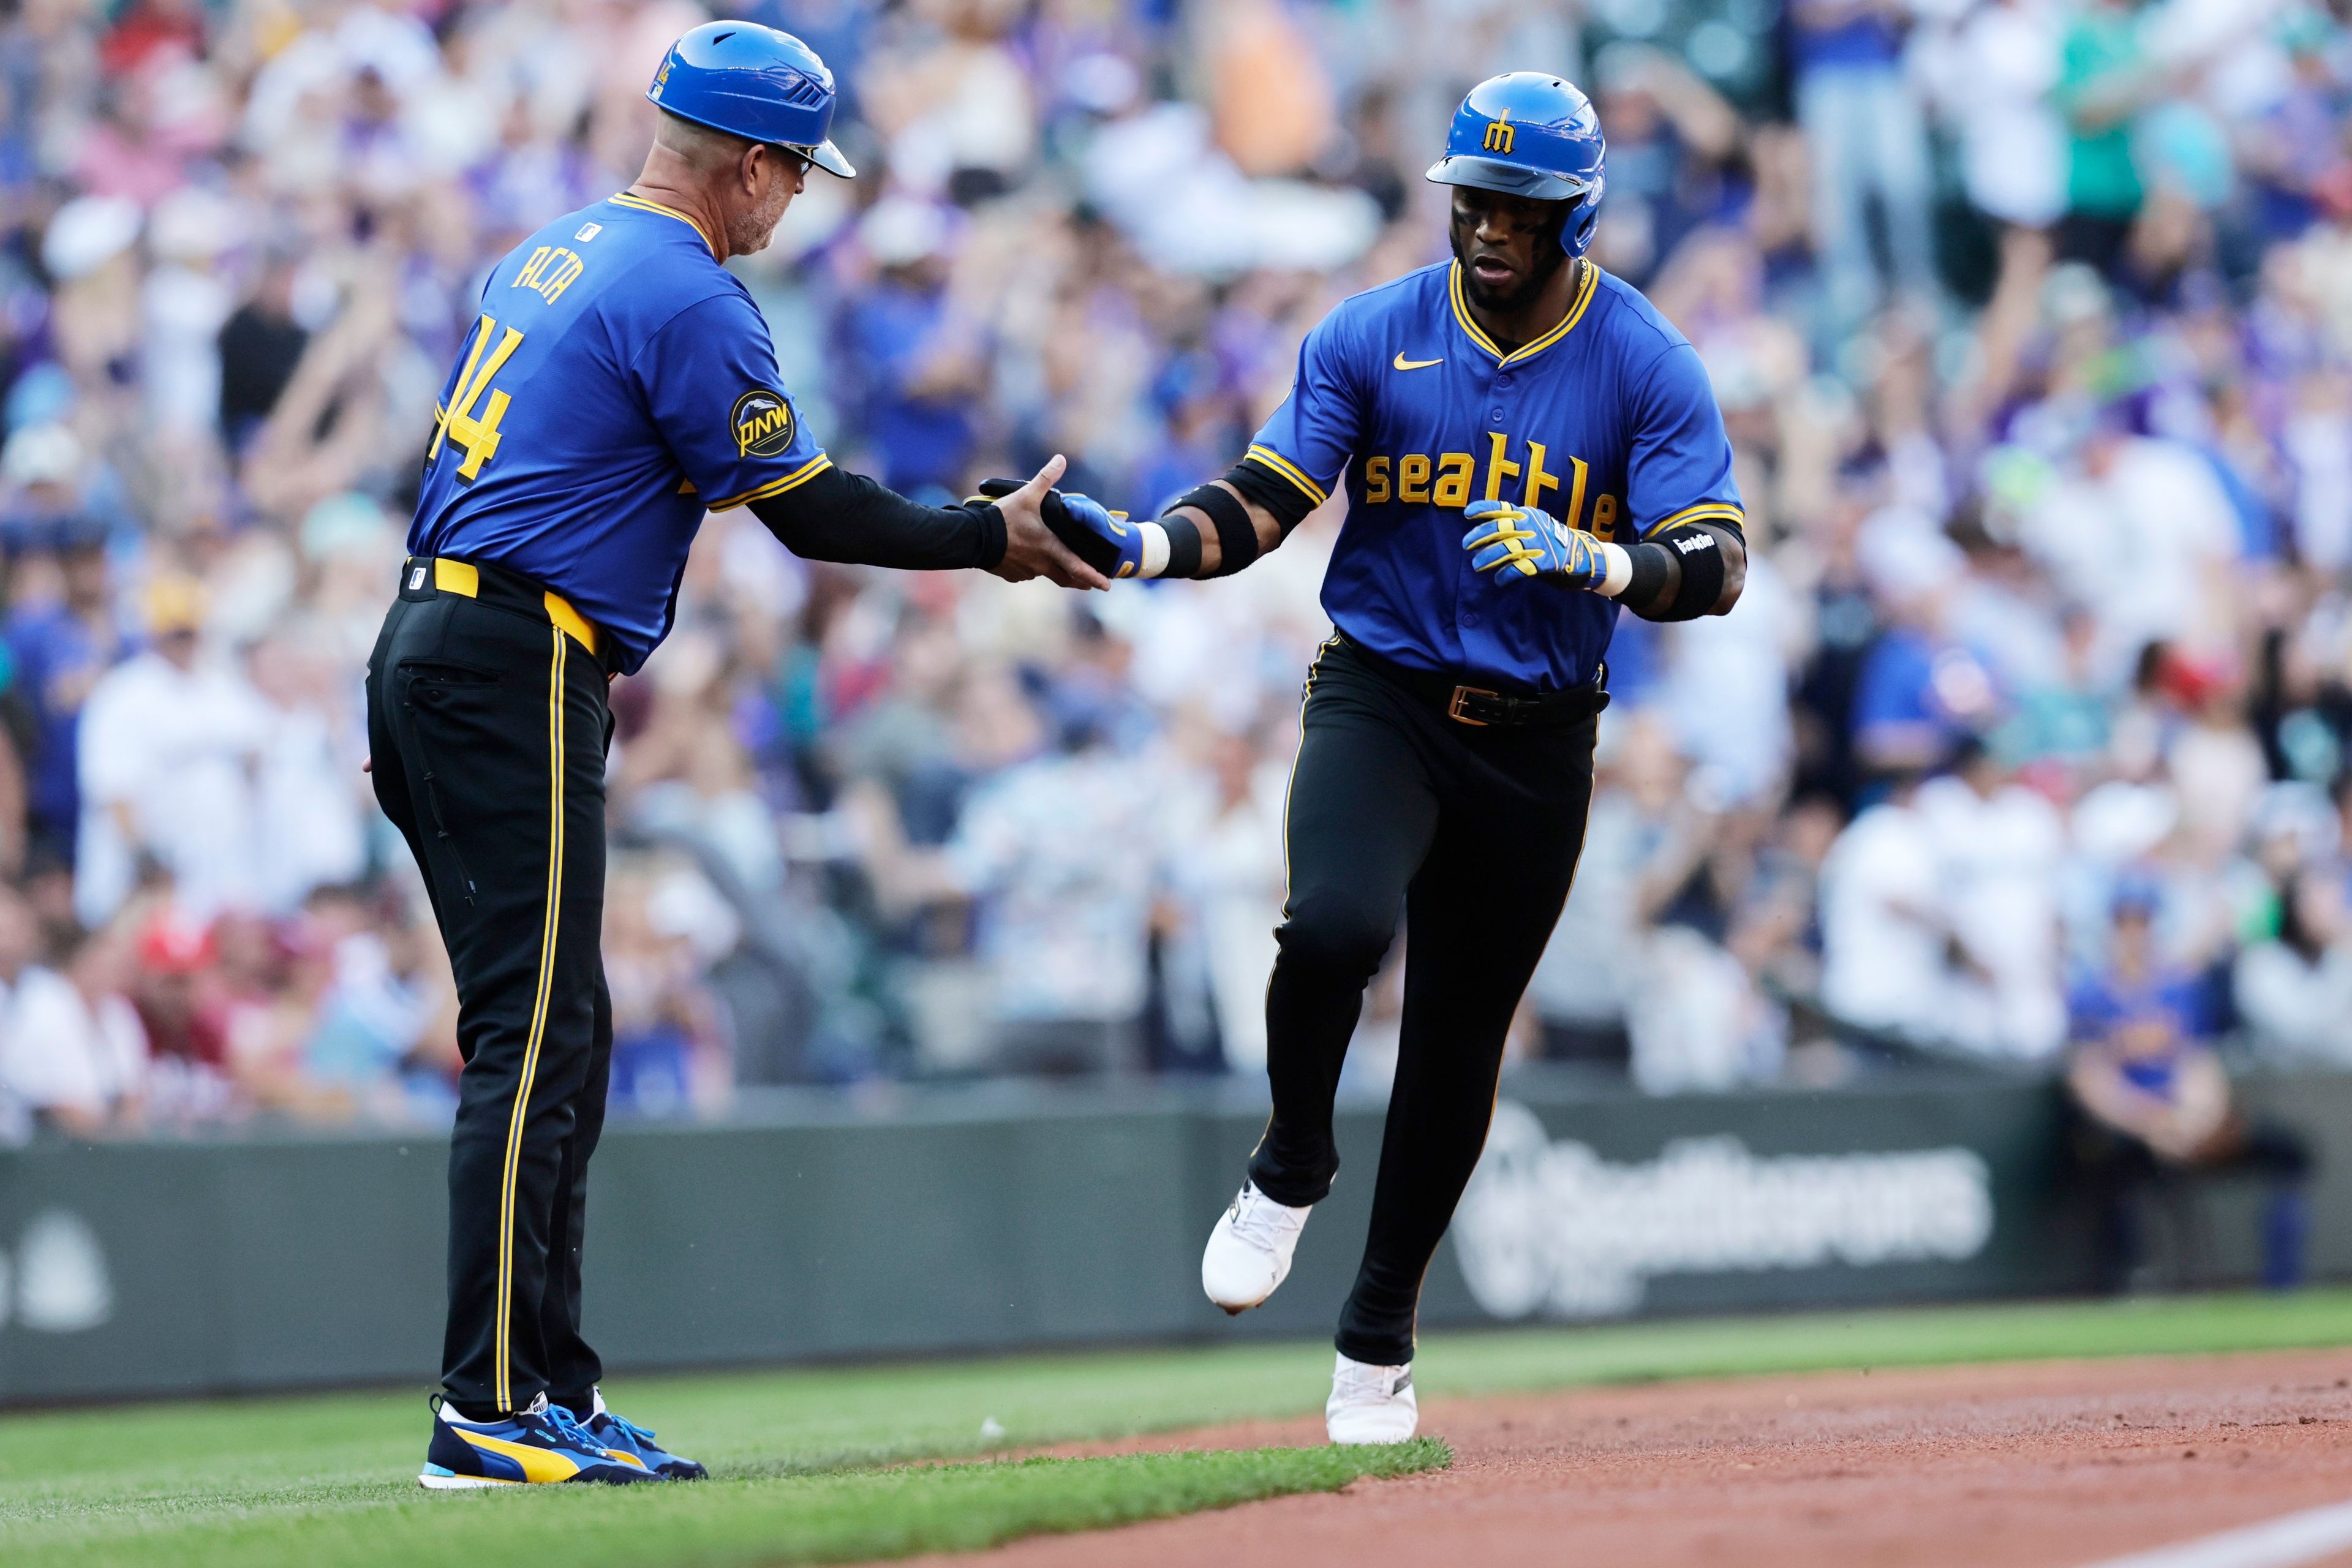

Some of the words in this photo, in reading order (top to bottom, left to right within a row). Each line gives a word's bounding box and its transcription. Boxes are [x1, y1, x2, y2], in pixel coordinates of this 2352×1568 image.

[510, 246, 584, 306] ACTA
[428, 314, 525, 484] 14
[739, 402, 788, 458] PNW
[1365, 431, 1617, 543] seattle
